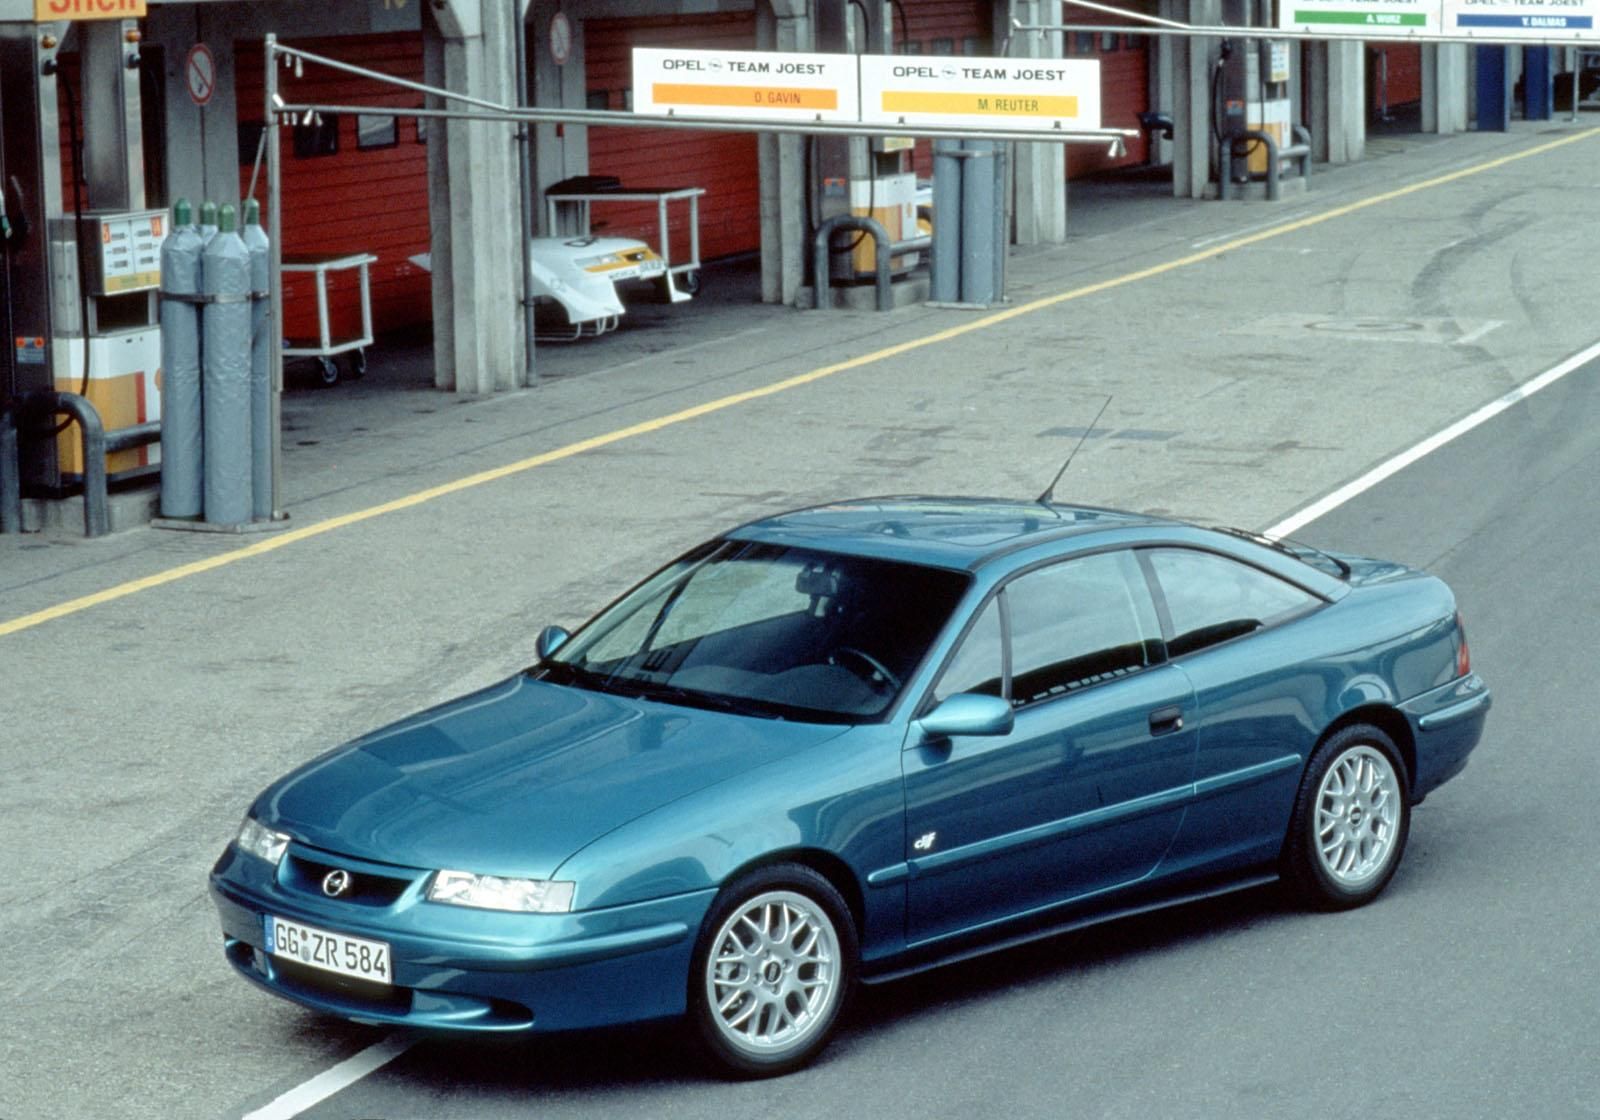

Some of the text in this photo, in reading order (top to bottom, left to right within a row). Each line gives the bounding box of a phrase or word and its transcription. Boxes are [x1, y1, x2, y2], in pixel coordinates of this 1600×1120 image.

[662, 59, 826, 75] OPEL TEAM JOEST
[892, 66, 1066, 81] OPEL TEAM JOEST
[767, 91, 801, 104] GAVIN
[994, 99, 1039, 112] REUTER
[311, 933, 339, 967] ZR
[344, 941, 386, 977] 584
